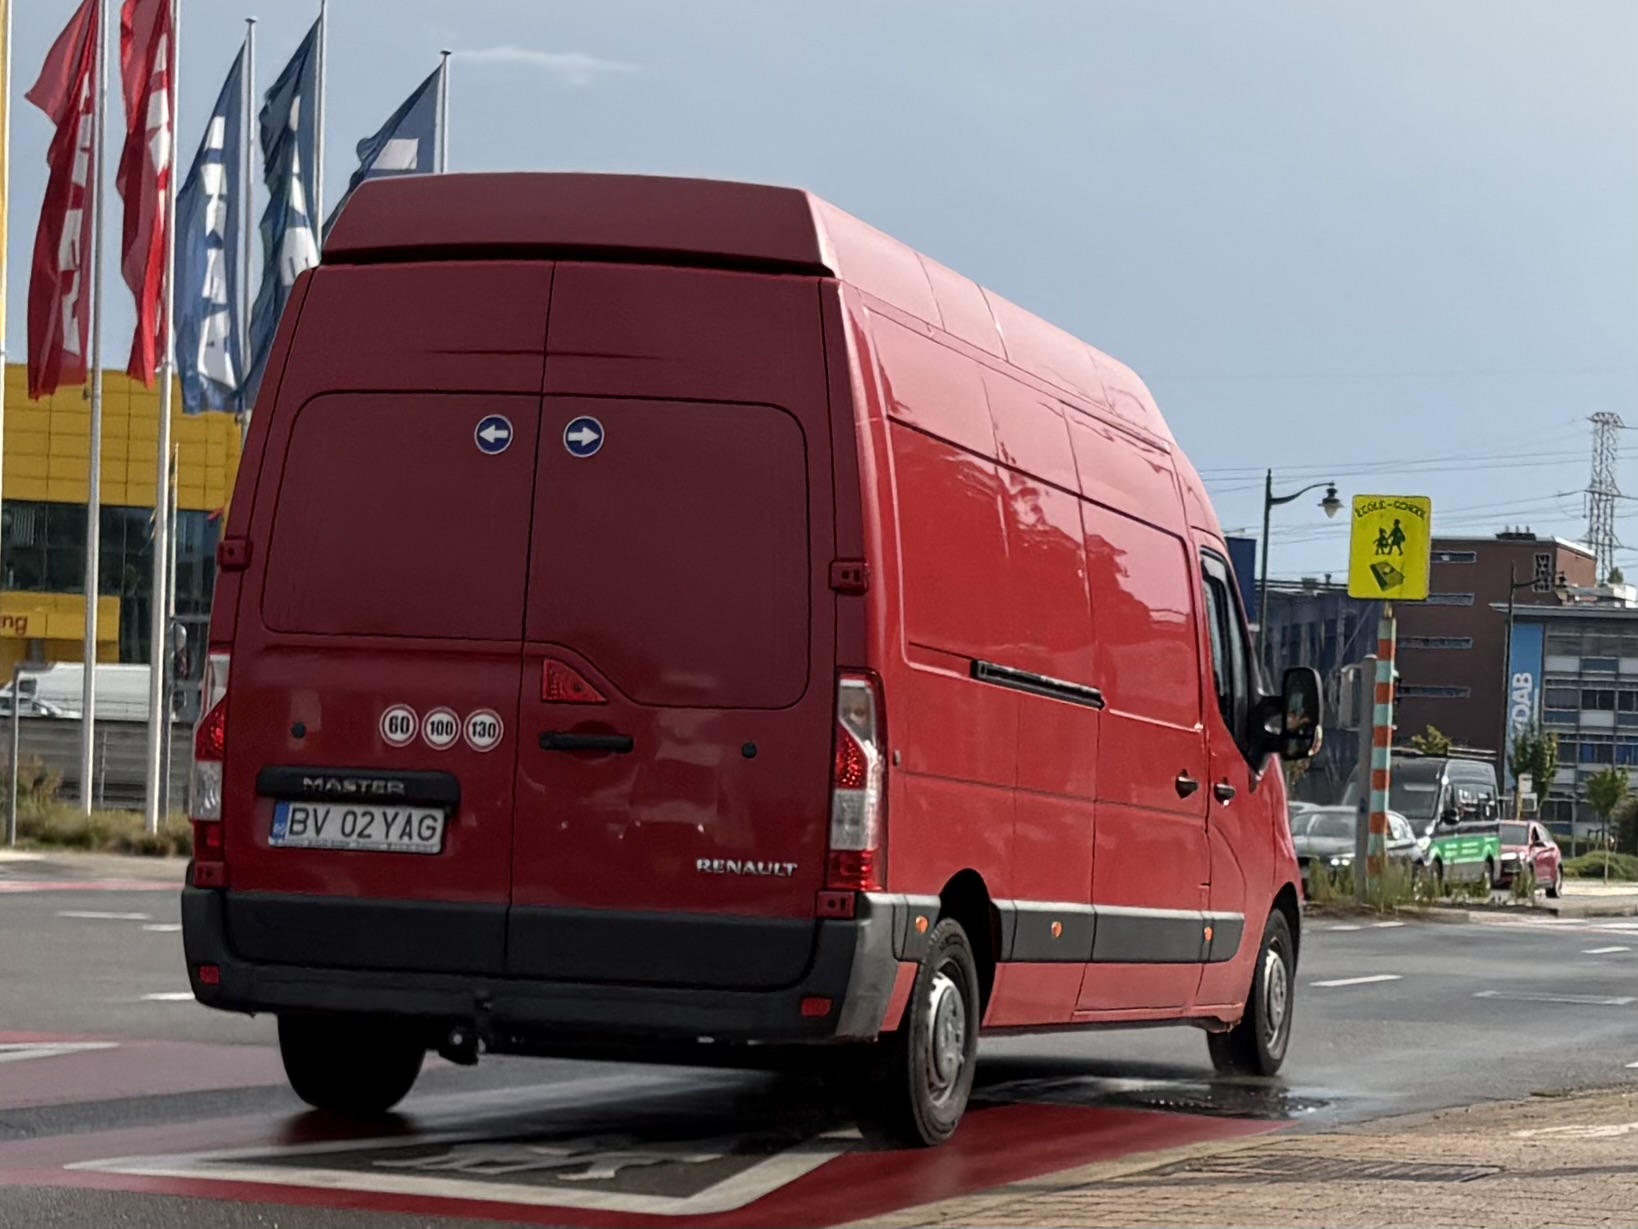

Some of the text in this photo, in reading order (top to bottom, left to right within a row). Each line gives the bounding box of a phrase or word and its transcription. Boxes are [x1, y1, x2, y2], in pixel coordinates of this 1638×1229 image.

[430, 719, 454, 737] 100
[472, 721, 497, 739] 130
[303, 776, 405, 795] MASTER
[289, 807, 330, 838] BV
[341, 809, 375, 839] 02
[382, 810, 438, 842] YAG
[696, 858, 798, 876] RENAULT
